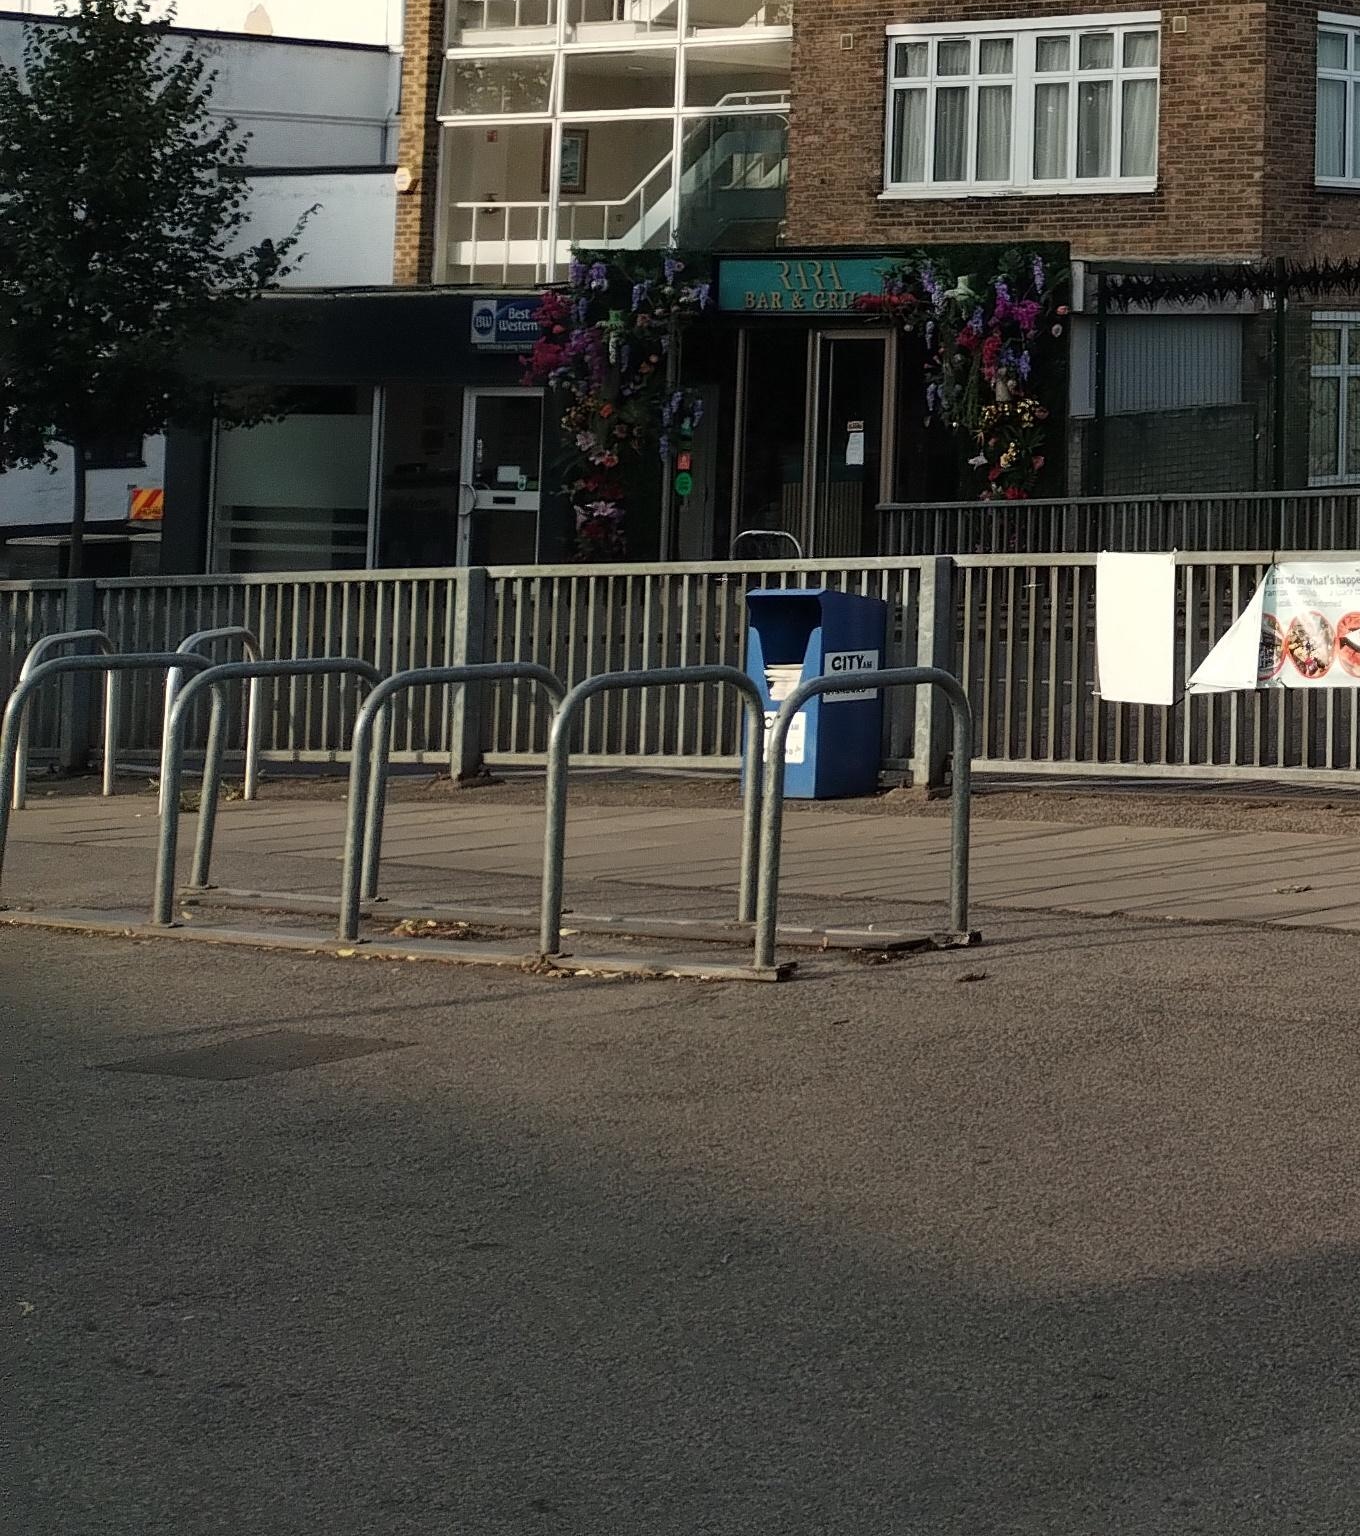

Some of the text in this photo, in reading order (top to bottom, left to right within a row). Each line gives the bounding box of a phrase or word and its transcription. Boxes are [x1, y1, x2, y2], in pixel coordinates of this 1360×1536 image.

[744, 291, 857, 309] BAR & GRI
[508, 307, 530, 319] Best
[499, 319, 538, 332] Western
[832, 655, 864, 671] CITY
